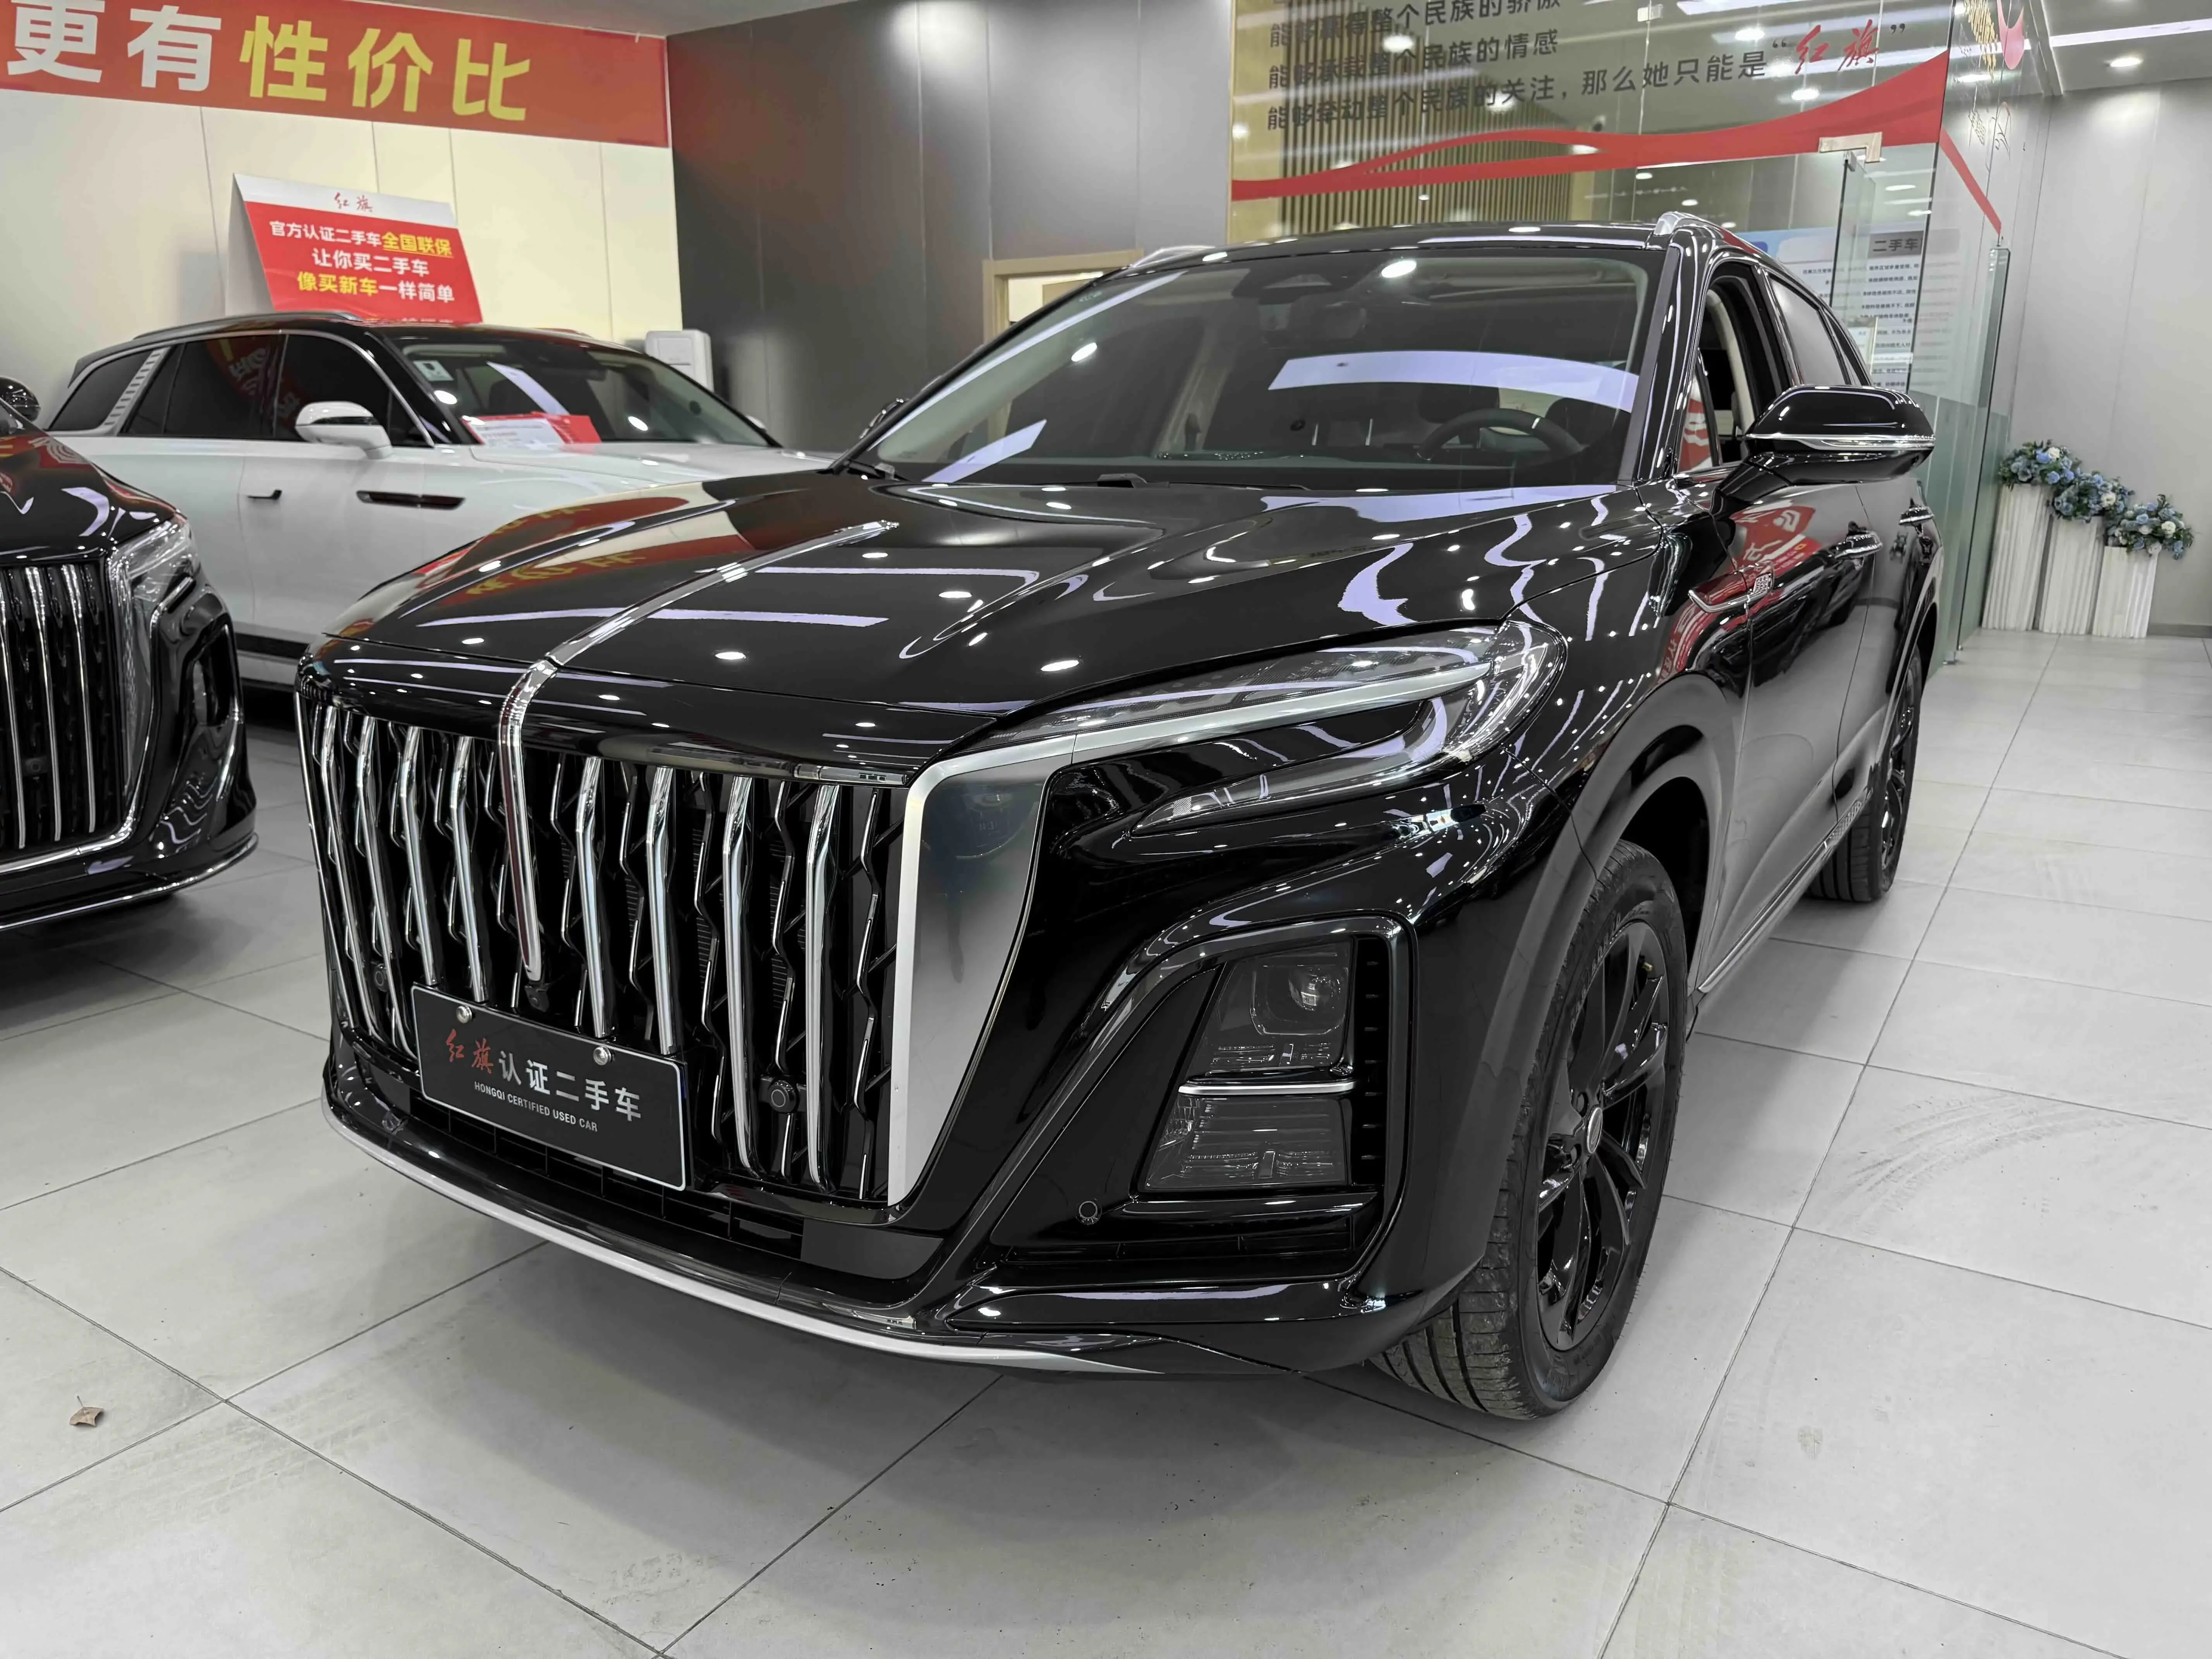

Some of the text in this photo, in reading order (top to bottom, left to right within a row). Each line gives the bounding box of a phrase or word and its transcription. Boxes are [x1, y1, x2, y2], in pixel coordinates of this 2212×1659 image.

[7, 0, 531, 121] 更有性价比
[334, 192, 374, 213] 红旗
[1873, 237, 1923, 252] 二手车
[312, 248, 430, 277] 让你买二手车
[297, 271, 455, 303] 像买新车一样简单
[474, 1081, 598, 1132] HONGQI CERTIFIED USED CAR
